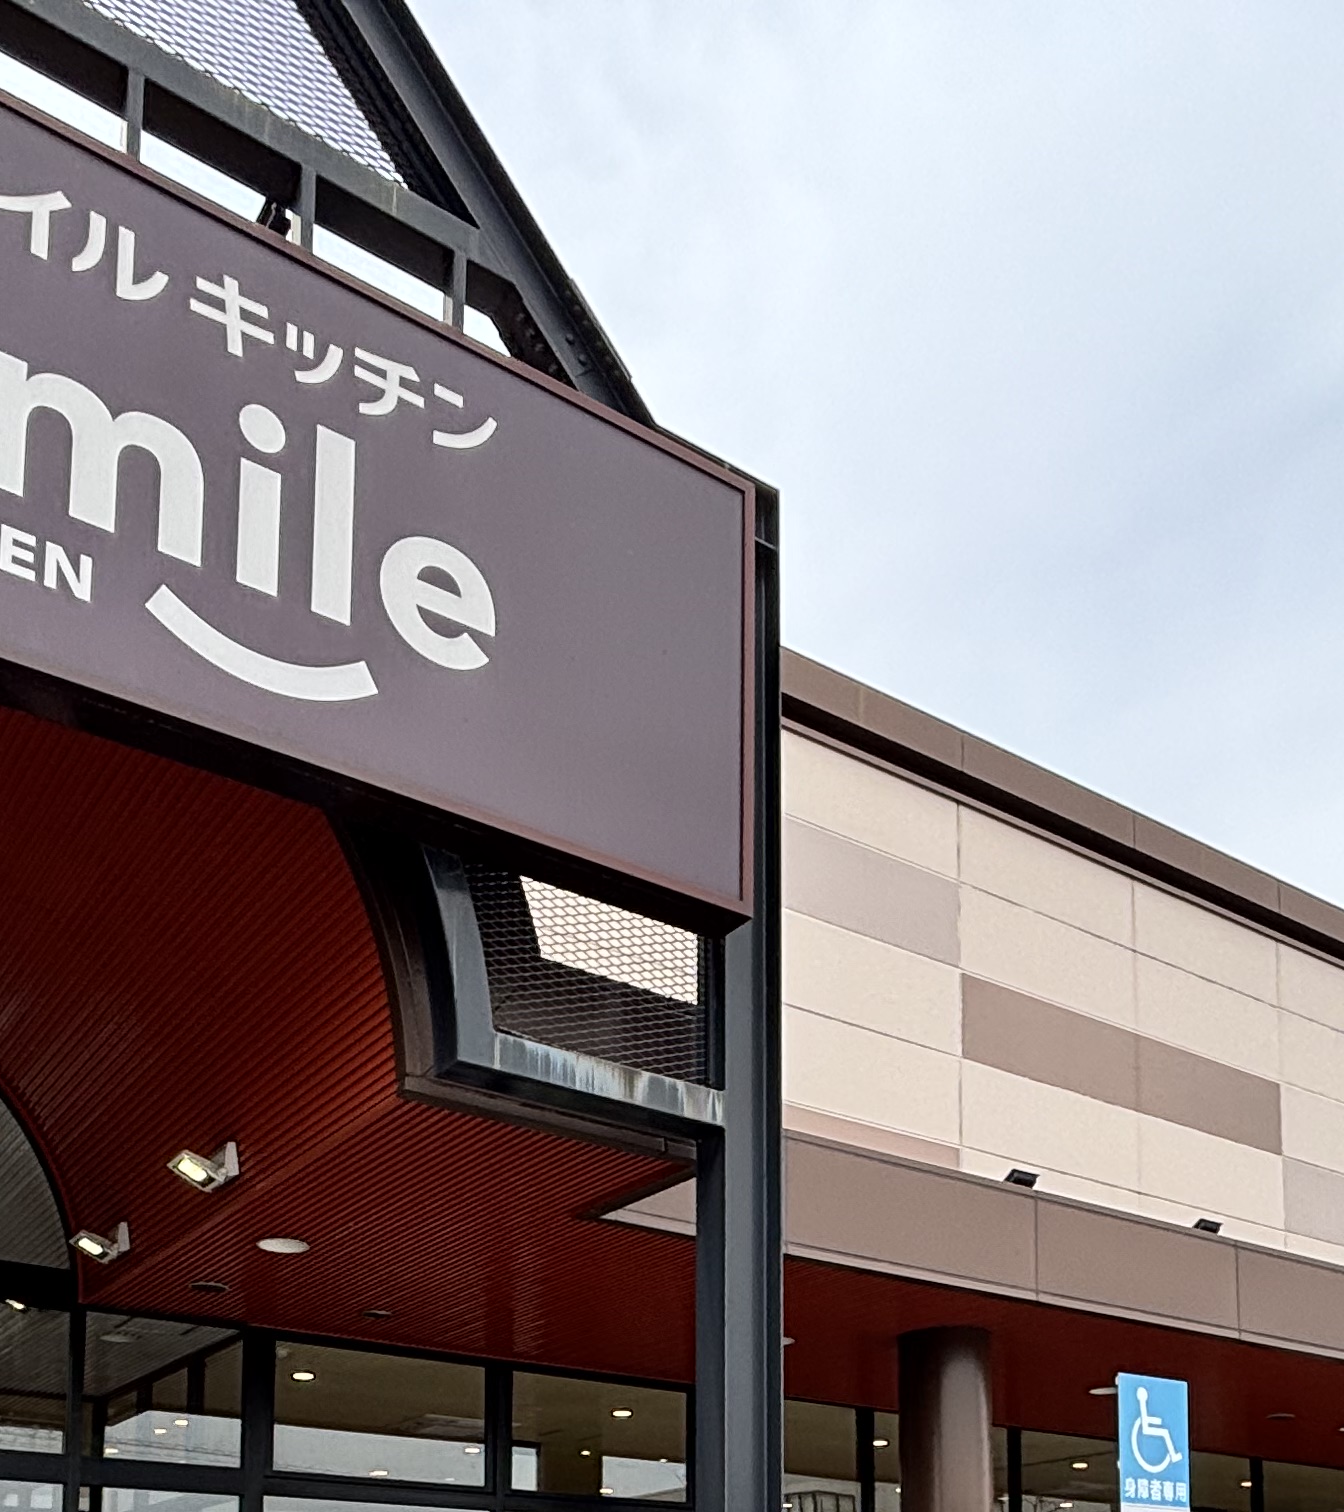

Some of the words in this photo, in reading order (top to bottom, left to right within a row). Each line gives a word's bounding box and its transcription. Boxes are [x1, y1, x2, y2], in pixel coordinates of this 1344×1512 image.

[190, 274, 497, 449] キッチン
[1124, 1478, 1187, 1502] 身障者専用
